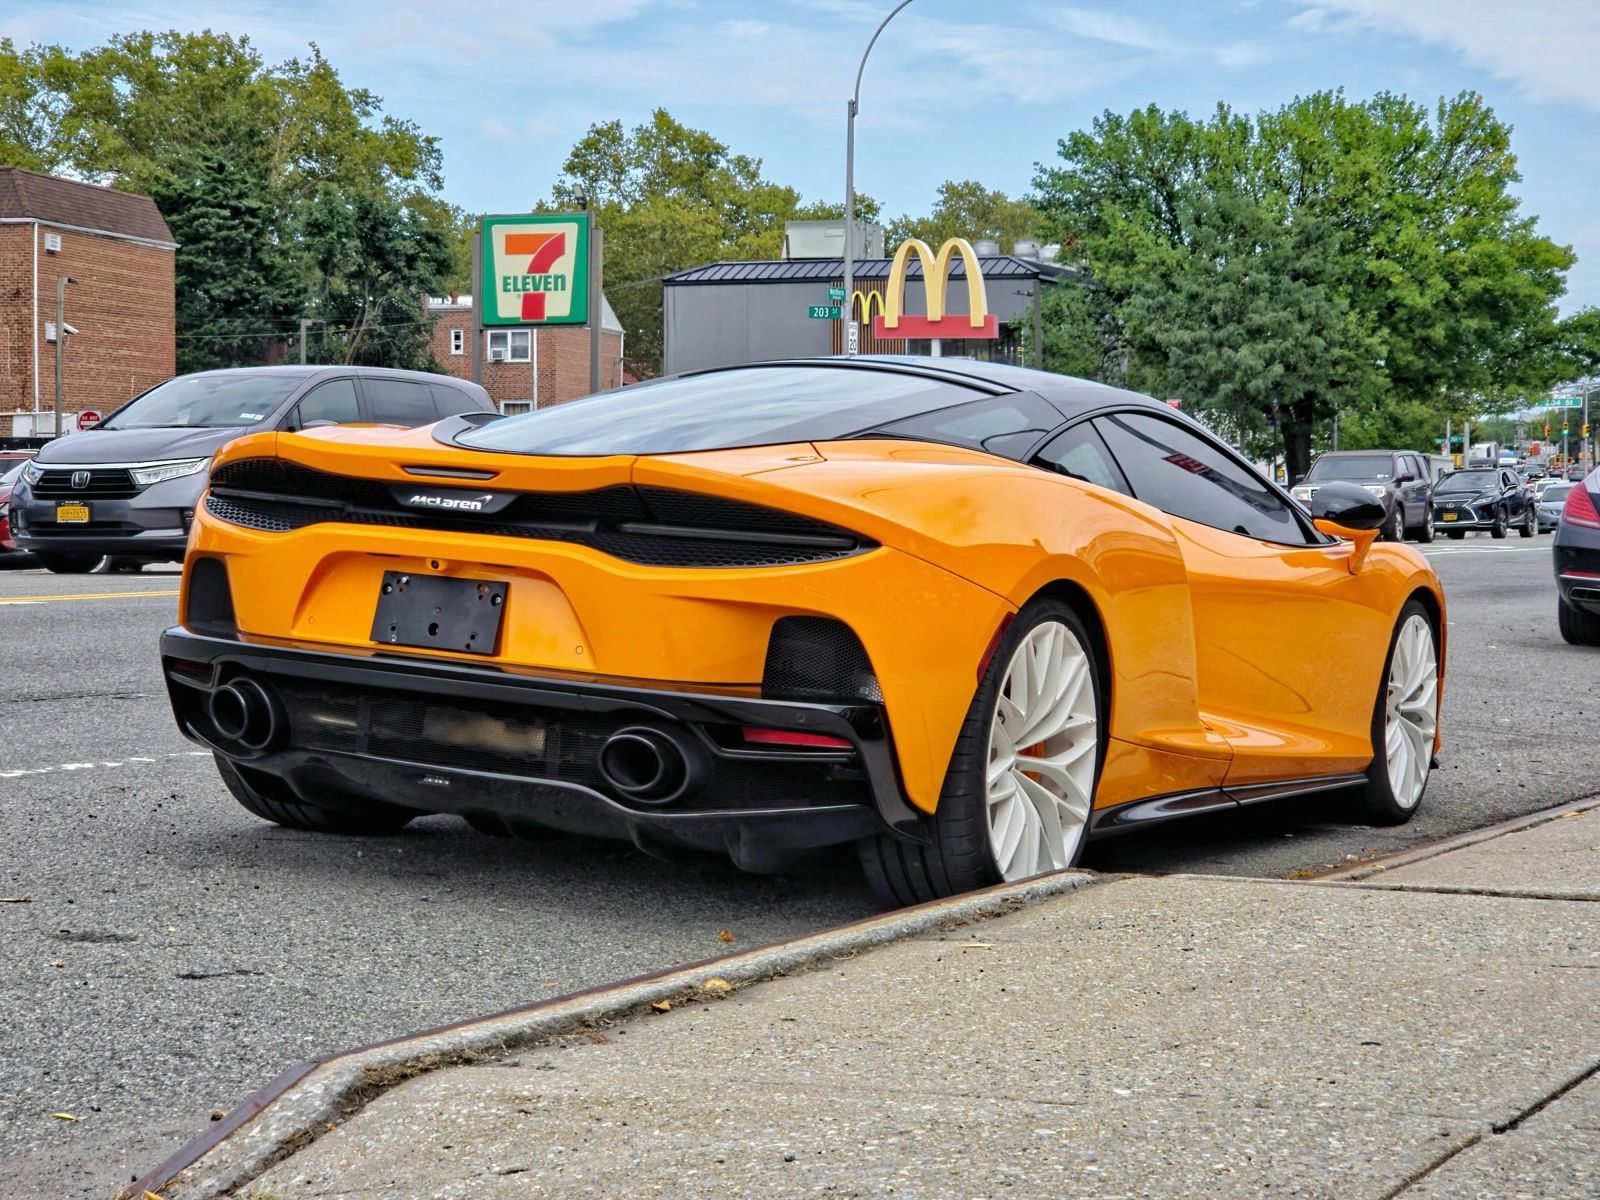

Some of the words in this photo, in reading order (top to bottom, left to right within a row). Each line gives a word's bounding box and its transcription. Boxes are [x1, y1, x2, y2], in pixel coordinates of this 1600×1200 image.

[505, 231, 566, 320] 7
[813, 307, 829, 317] 203
[409, 495, 482, 510] McLaren
